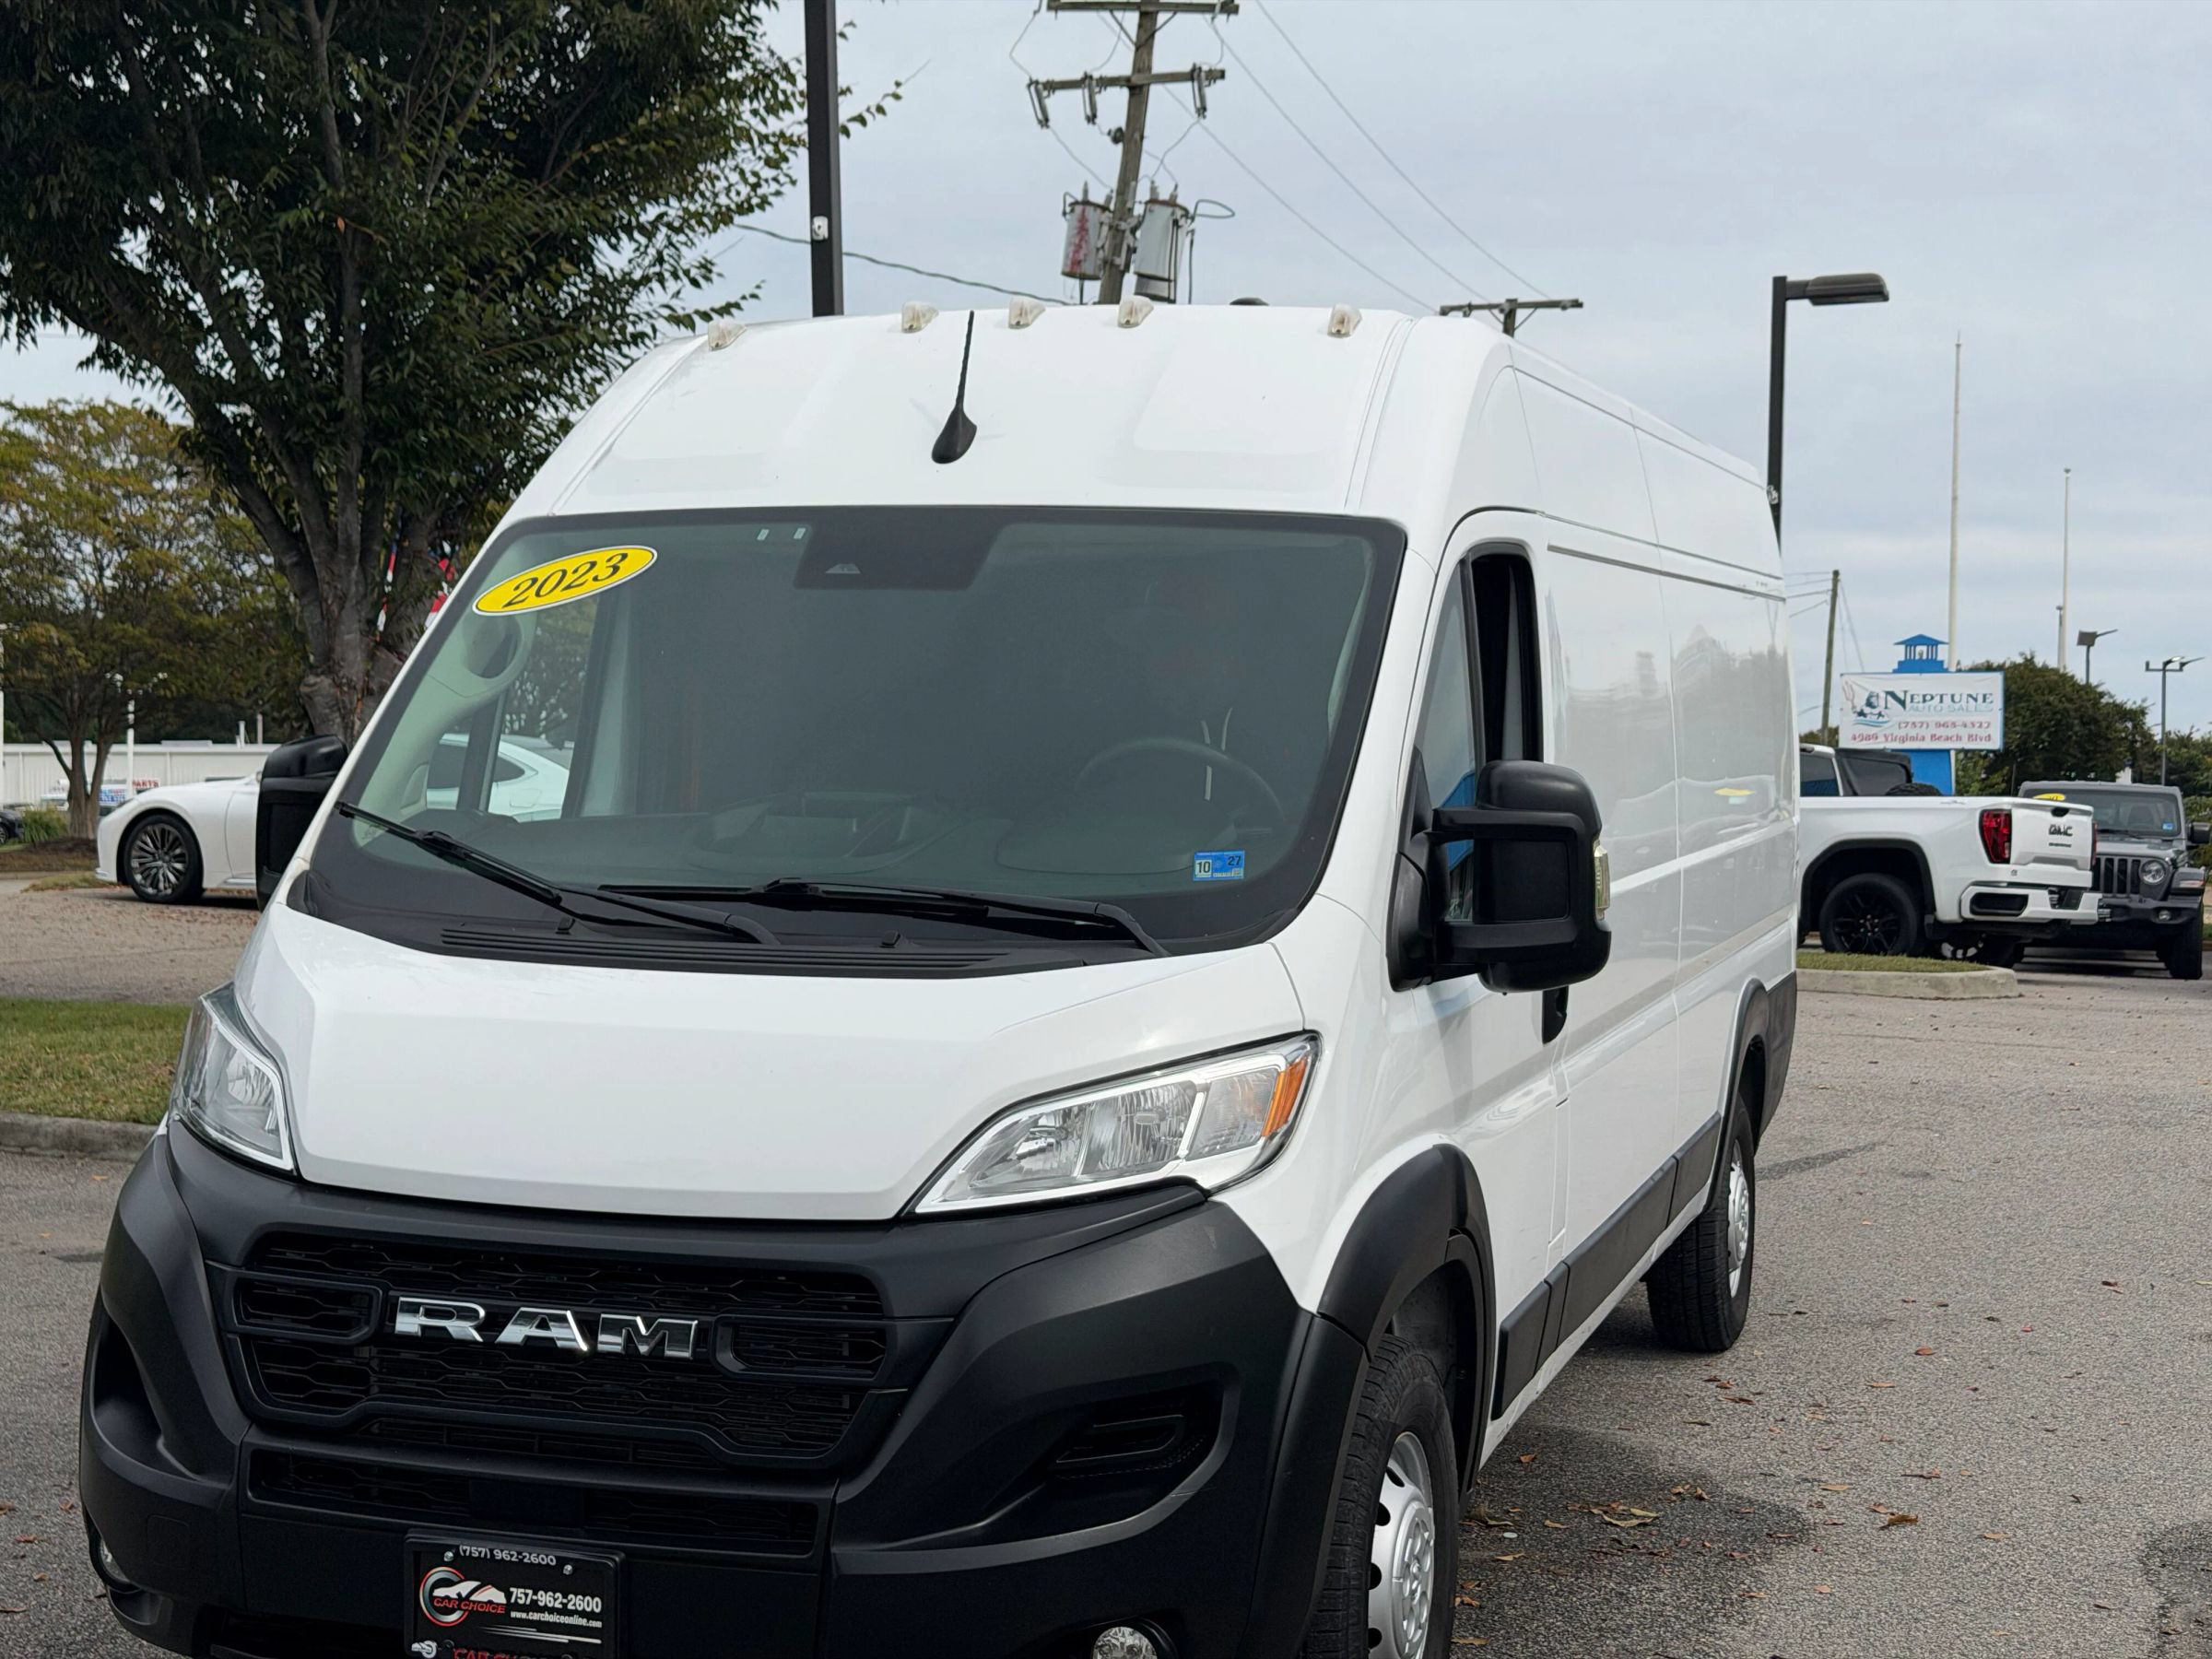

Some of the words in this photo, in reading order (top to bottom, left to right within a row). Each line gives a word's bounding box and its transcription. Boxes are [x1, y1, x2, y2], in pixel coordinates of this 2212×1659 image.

[501, 552, 629, 608] 2023
[1883, 689, 1994, 711] NEPTUNE
[1898, 721, 1929, 730] (757)
[1883, 732, 1925, 744] Virginia
[1930, 733, 1962, 742] Beach
[1968, 733, 1992, 742] Blvd
[1196, 861, 1211, 874] 10
[1228, 855, 1241, 866] 27
[394, 1296, 699, 1359] RAM
[459, 1545, 491, 1559] (757)
[493, 1549, 557, 1567] 962-2600
[433, 1597, 459, 1609] CAR
[460, 1601, 507, 1614] CHOICE
[510, 1587, 602, 1614] 757-962-2600
[510, 1609, 603, 1629] www.carchoiceonline.com
